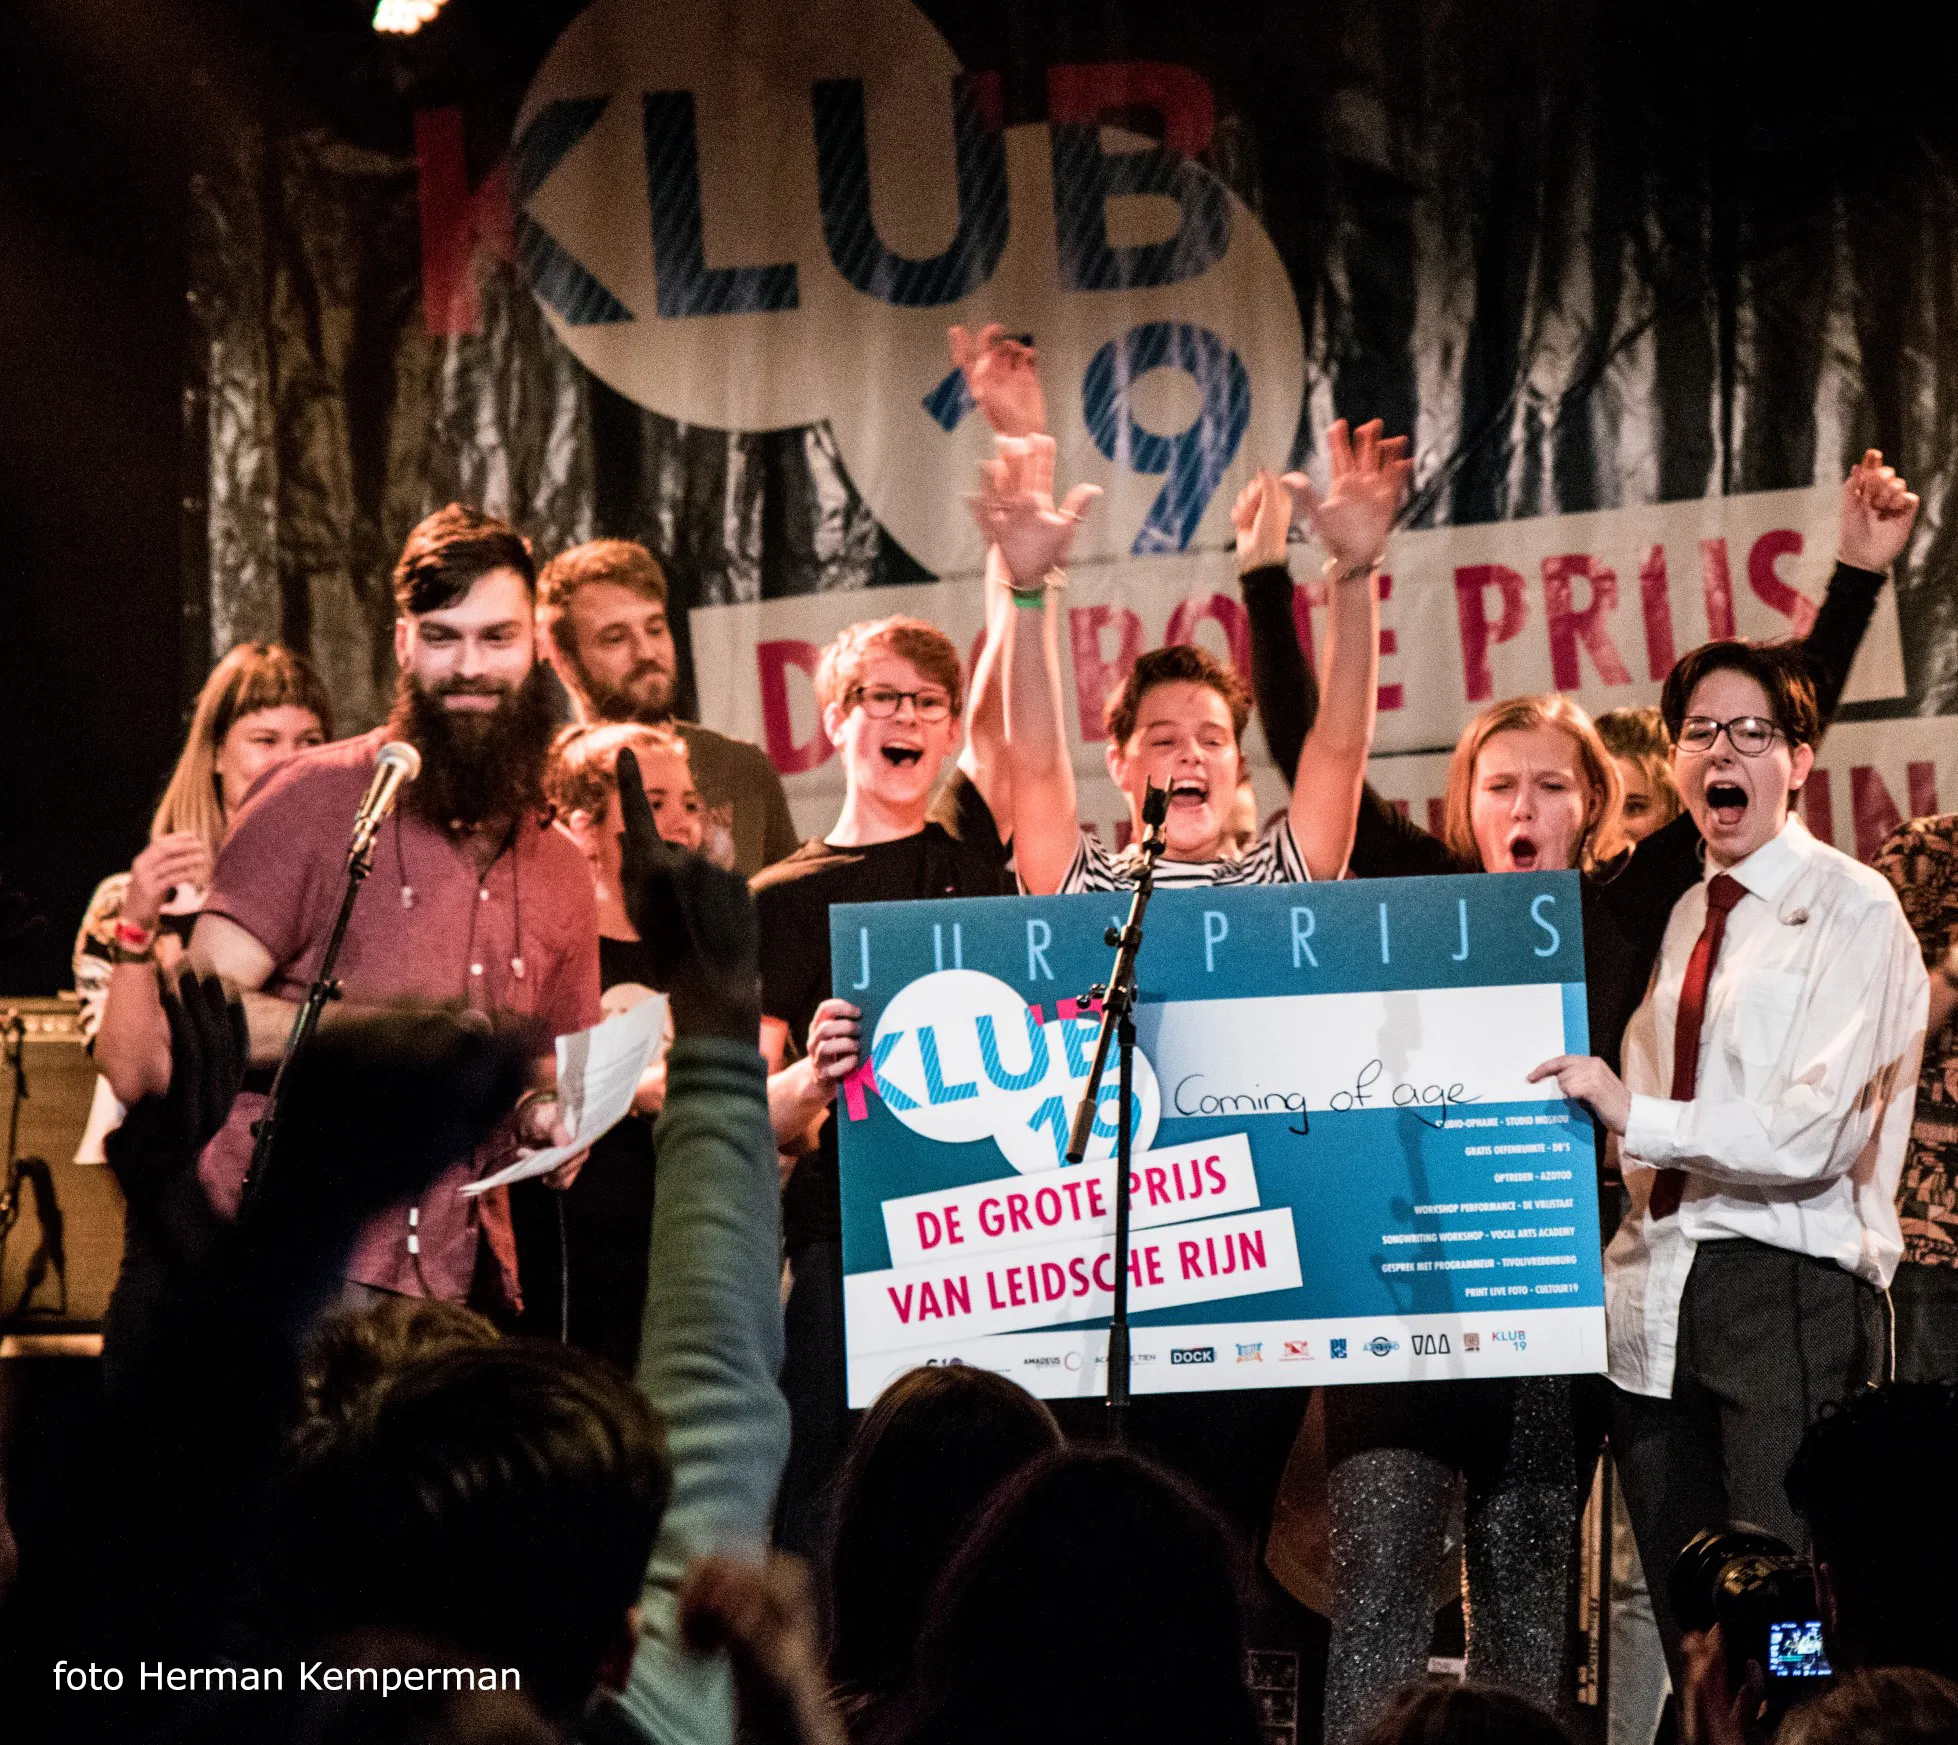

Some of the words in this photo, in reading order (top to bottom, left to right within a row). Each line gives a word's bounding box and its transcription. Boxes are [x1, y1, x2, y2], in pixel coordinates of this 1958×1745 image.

[414, 62, 1232, 335] KLUB
[1174, 1073, 1309, 1135] Coming
[1330, 1059, 1383, 1112] of
[1392, 1080, 1484, 1128] age
[915, 1205, 965, 1250] DE
[978, 1177, 1107, 1238] GROTE
[1127, 1155, 1227, 1212] PRIJS
[1414, 1204, 1458, 1215] WORKSHOP
[1460, 1201, 1516, 1213] PERFORMANCE
[1382, 1233, 1437, 1245] SONGWRITING
[1439, 1231, 1483, 1242] WORKSHOP
[1491, 1229, 1516, 1240] VOCAL
[1518, 1228, 1537, 1238] ARTS
[887, 1276, 972, 1325] VAN
[987, 1246, 1165, 1311] LEIDSCHE
[1177, 1229, 1268, 1281] RIJN
[1465, 1287, 1488, 1298] PRINT
[1490, 1286, 1507, 1297] LIVE
[1508, 1285, 1528, 1296] FOTO
[1492, 1330, 1526, 1341] KLUB
[1513, 1341, 1527, 1351] 19
[1173, 1351, 1214, 1362] DOCK
